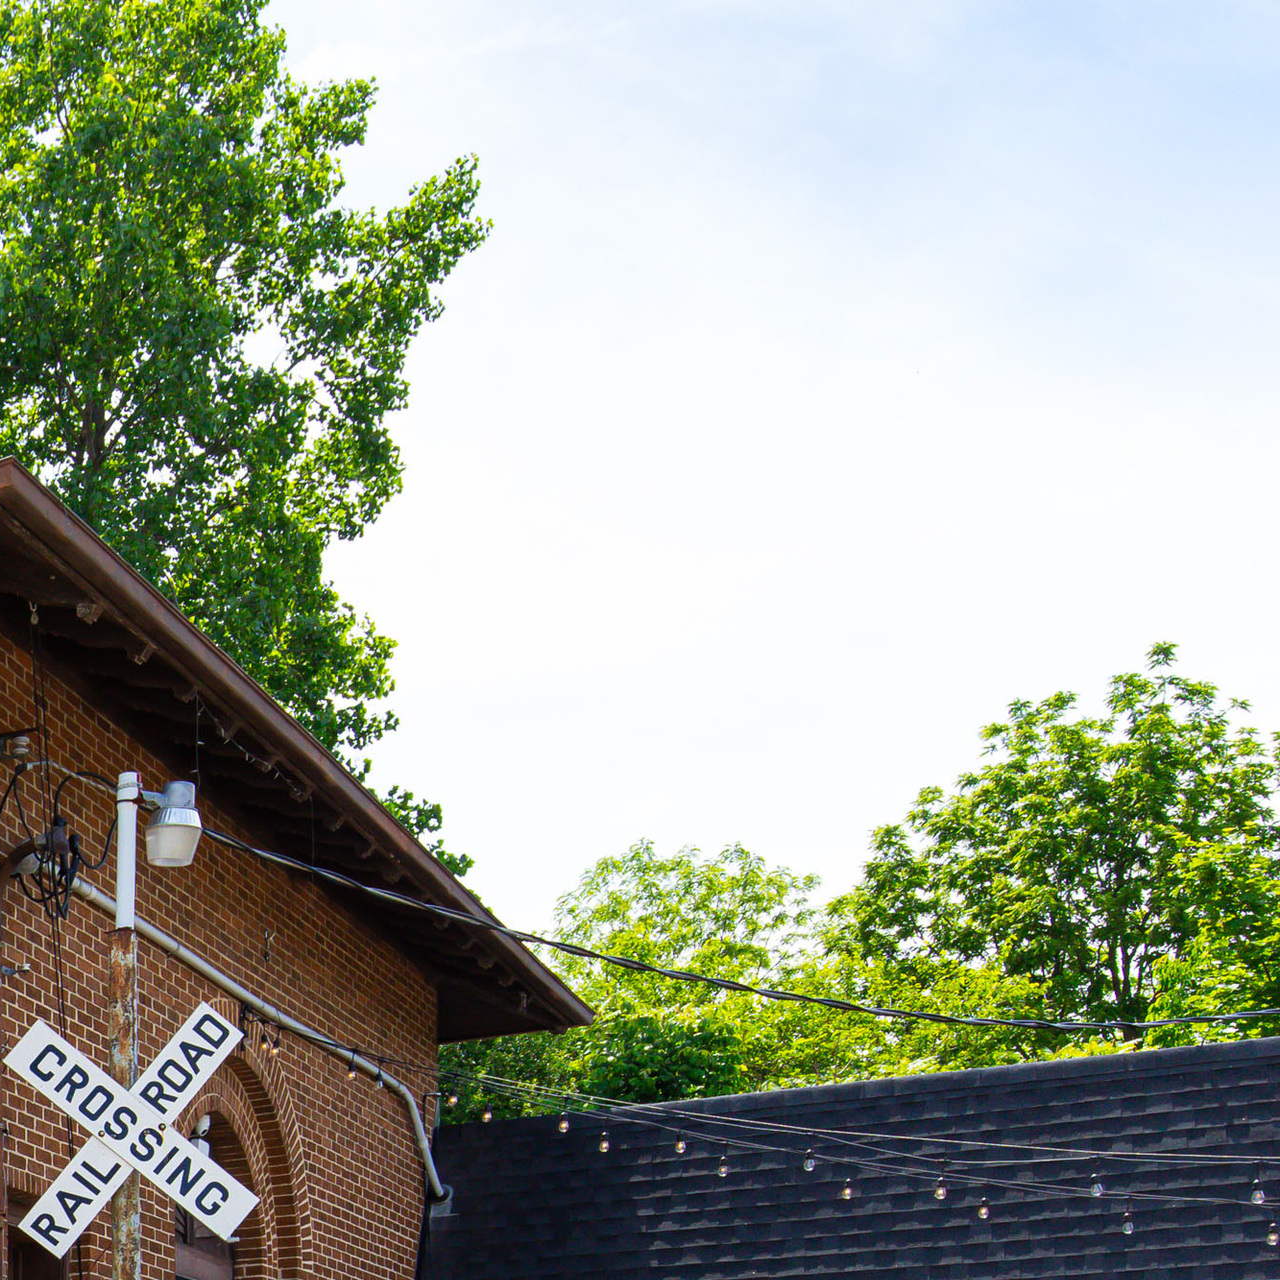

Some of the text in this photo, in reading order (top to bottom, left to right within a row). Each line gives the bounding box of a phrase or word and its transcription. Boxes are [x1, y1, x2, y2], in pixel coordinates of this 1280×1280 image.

[29, 1044, 230, 1216] CROSSING
[30, 1013, 230, 1247] RAIL ROAD
